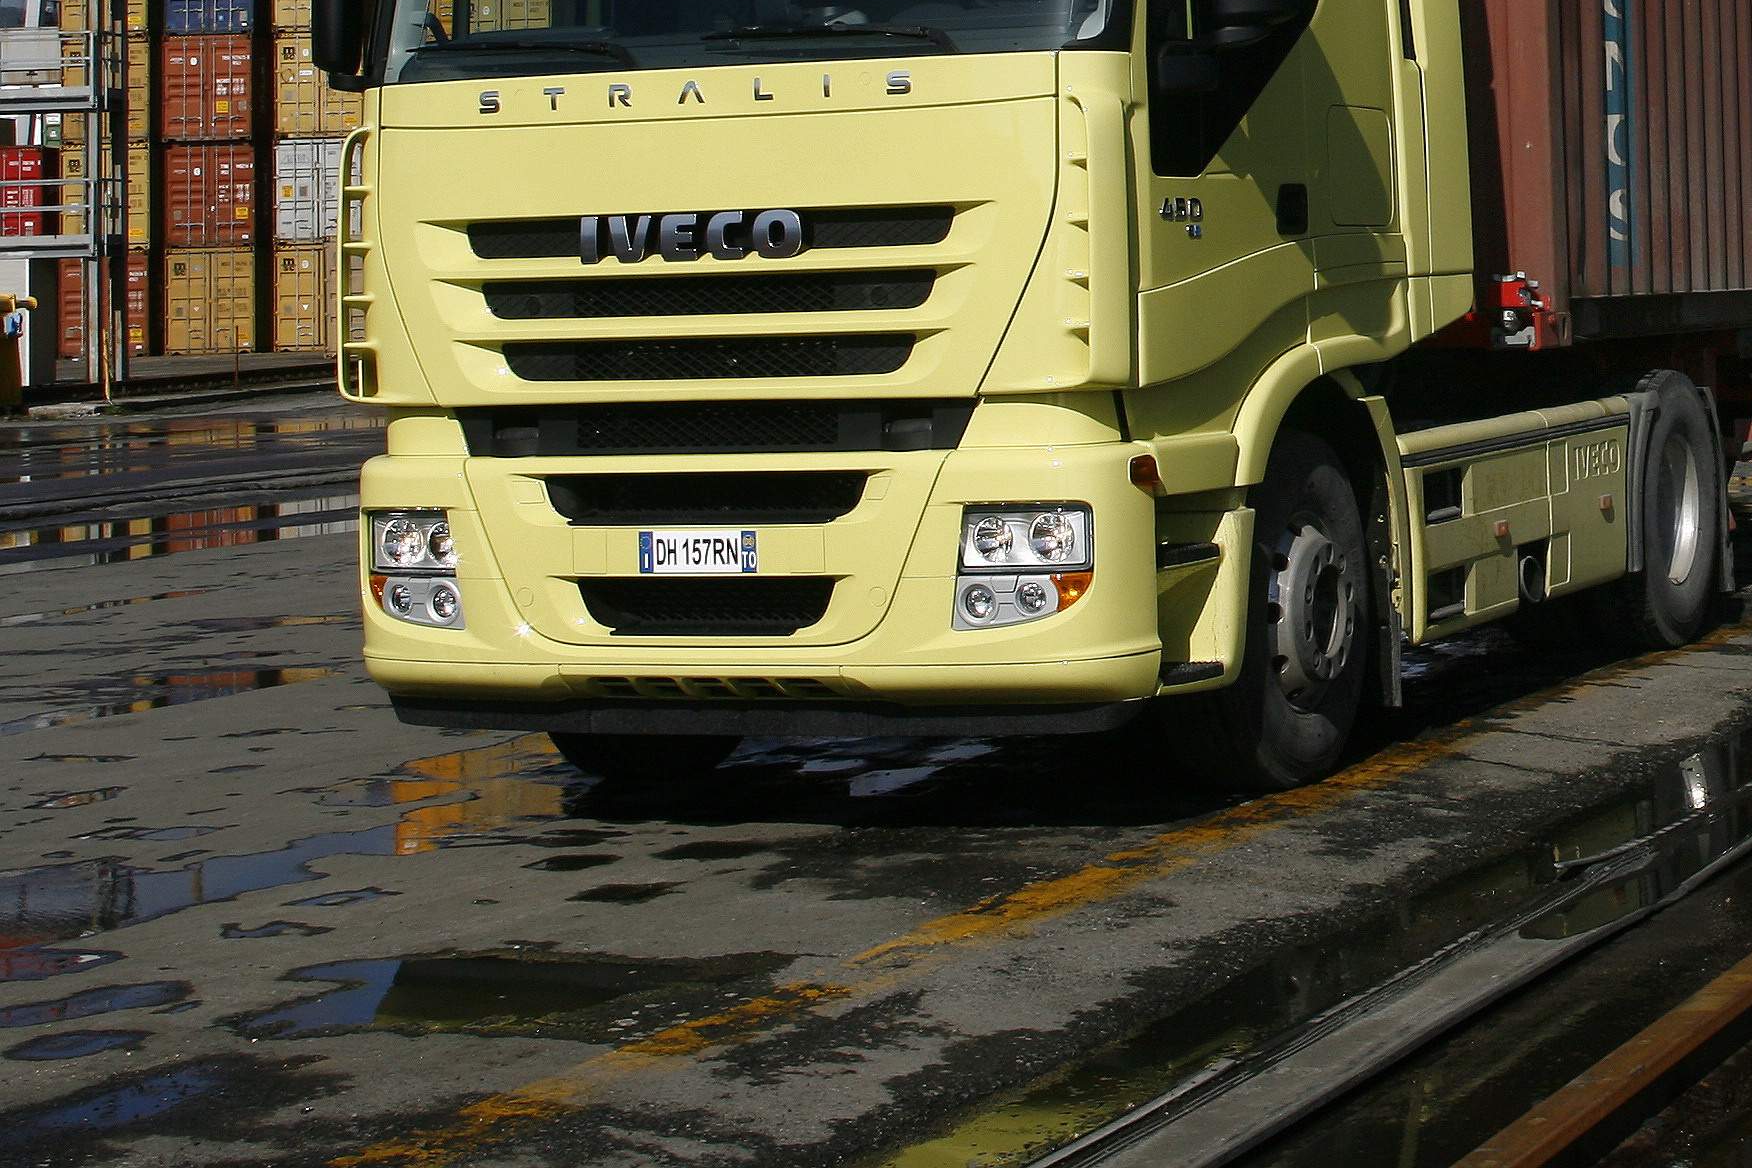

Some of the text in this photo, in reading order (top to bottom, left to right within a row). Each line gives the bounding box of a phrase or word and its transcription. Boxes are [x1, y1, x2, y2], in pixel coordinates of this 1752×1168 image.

[479, 70, 912, 114] STRALIS
[579, 208, 803, 265] IVECO
[1573, 439, 1621, 481] IVECO
[656, 538, 677, 565] DH
[682, 538, 739, 565] 157RN
[742, 551, 757, 569] TO
